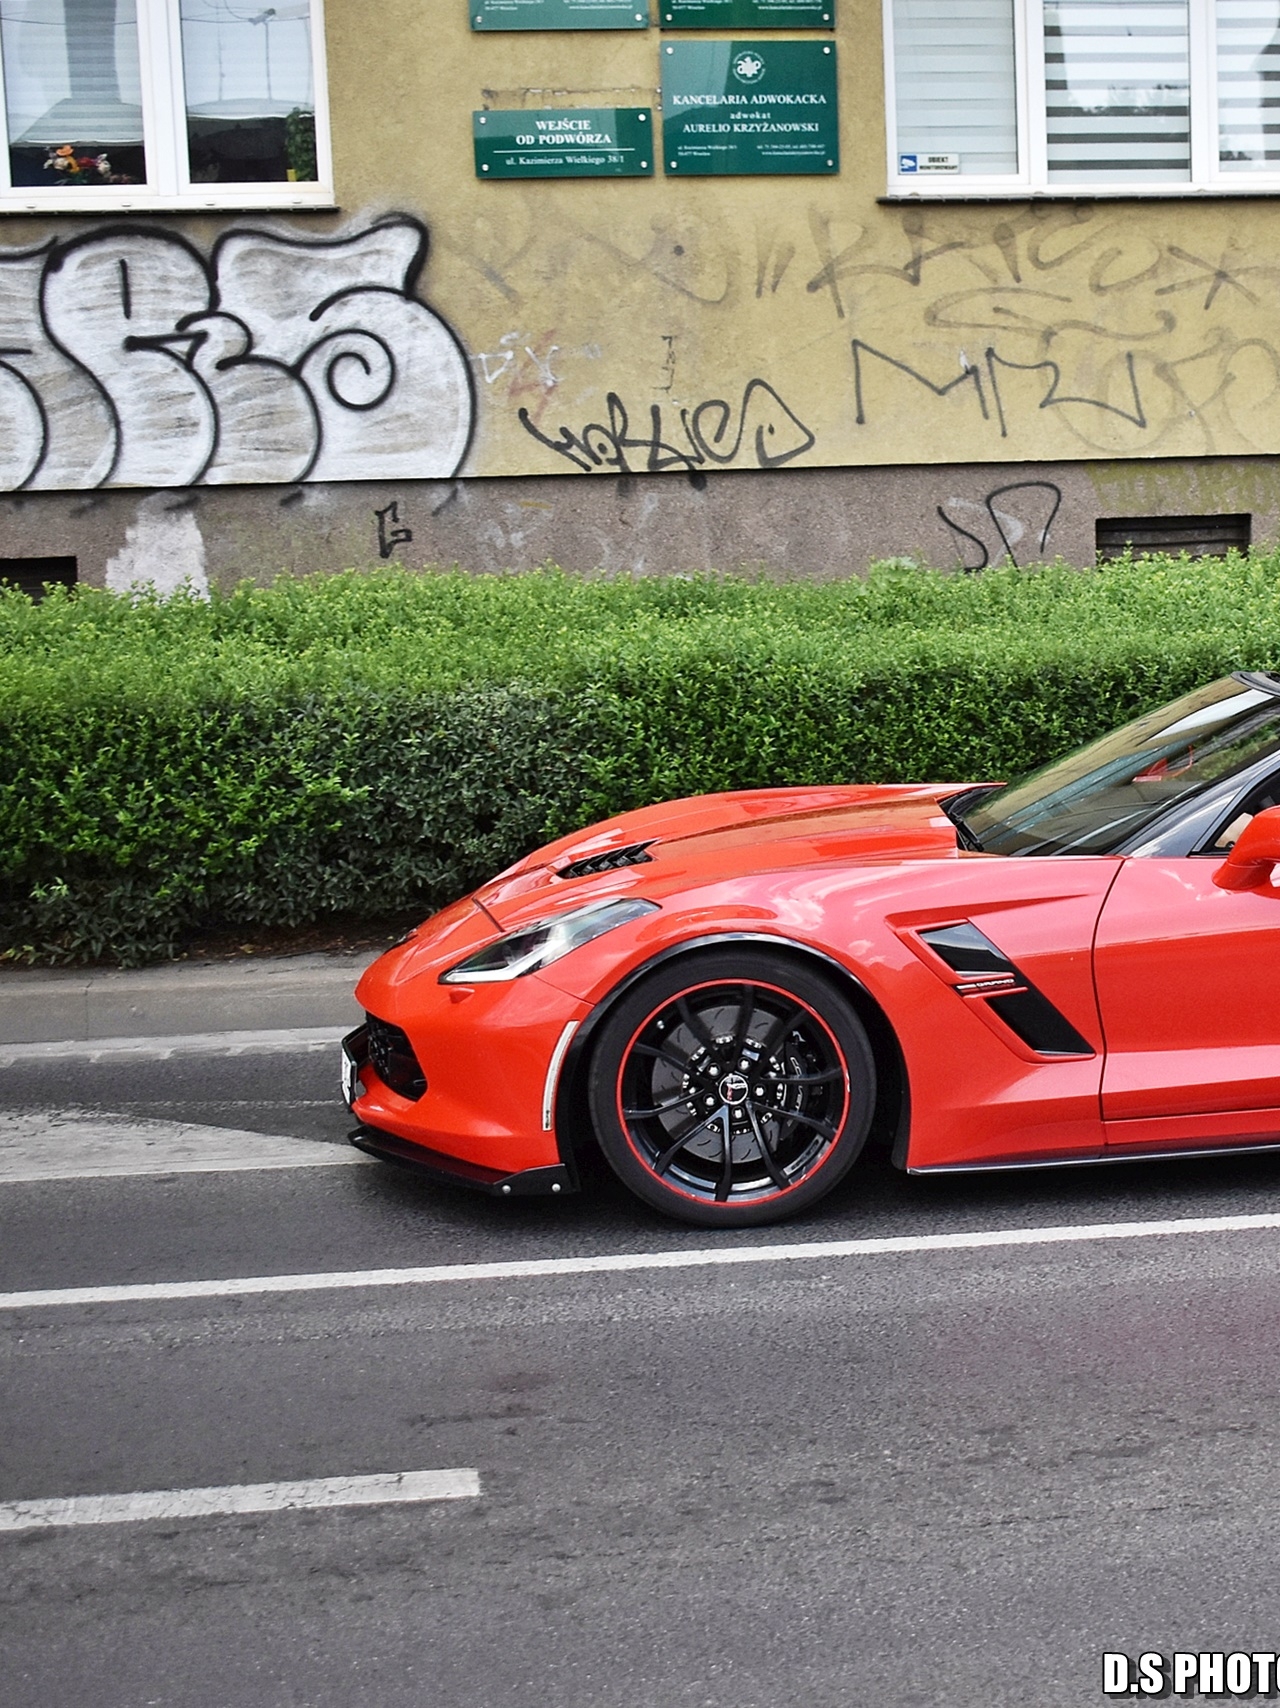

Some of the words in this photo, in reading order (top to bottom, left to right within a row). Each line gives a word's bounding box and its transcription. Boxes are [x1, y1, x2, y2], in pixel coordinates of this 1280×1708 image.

[673, 95, 748, 105] KANCELARIA
[750, 94, 827, 104] ADWOKACKA
[730, 111, 771, 119] adwokat
[535, 117, 592, 130] WEJŚCIE
[683, 123, 731, 133] AURELIO
[733, 121, 819, 132] KRZYŻANOWSKI
[516, 135, 535, 145] OD
[538, 132, 612, 145] PODWÓRZA
[518, 156, 563, 165] Kazimierza
[565, 155, 606, 165] Wielkiego
